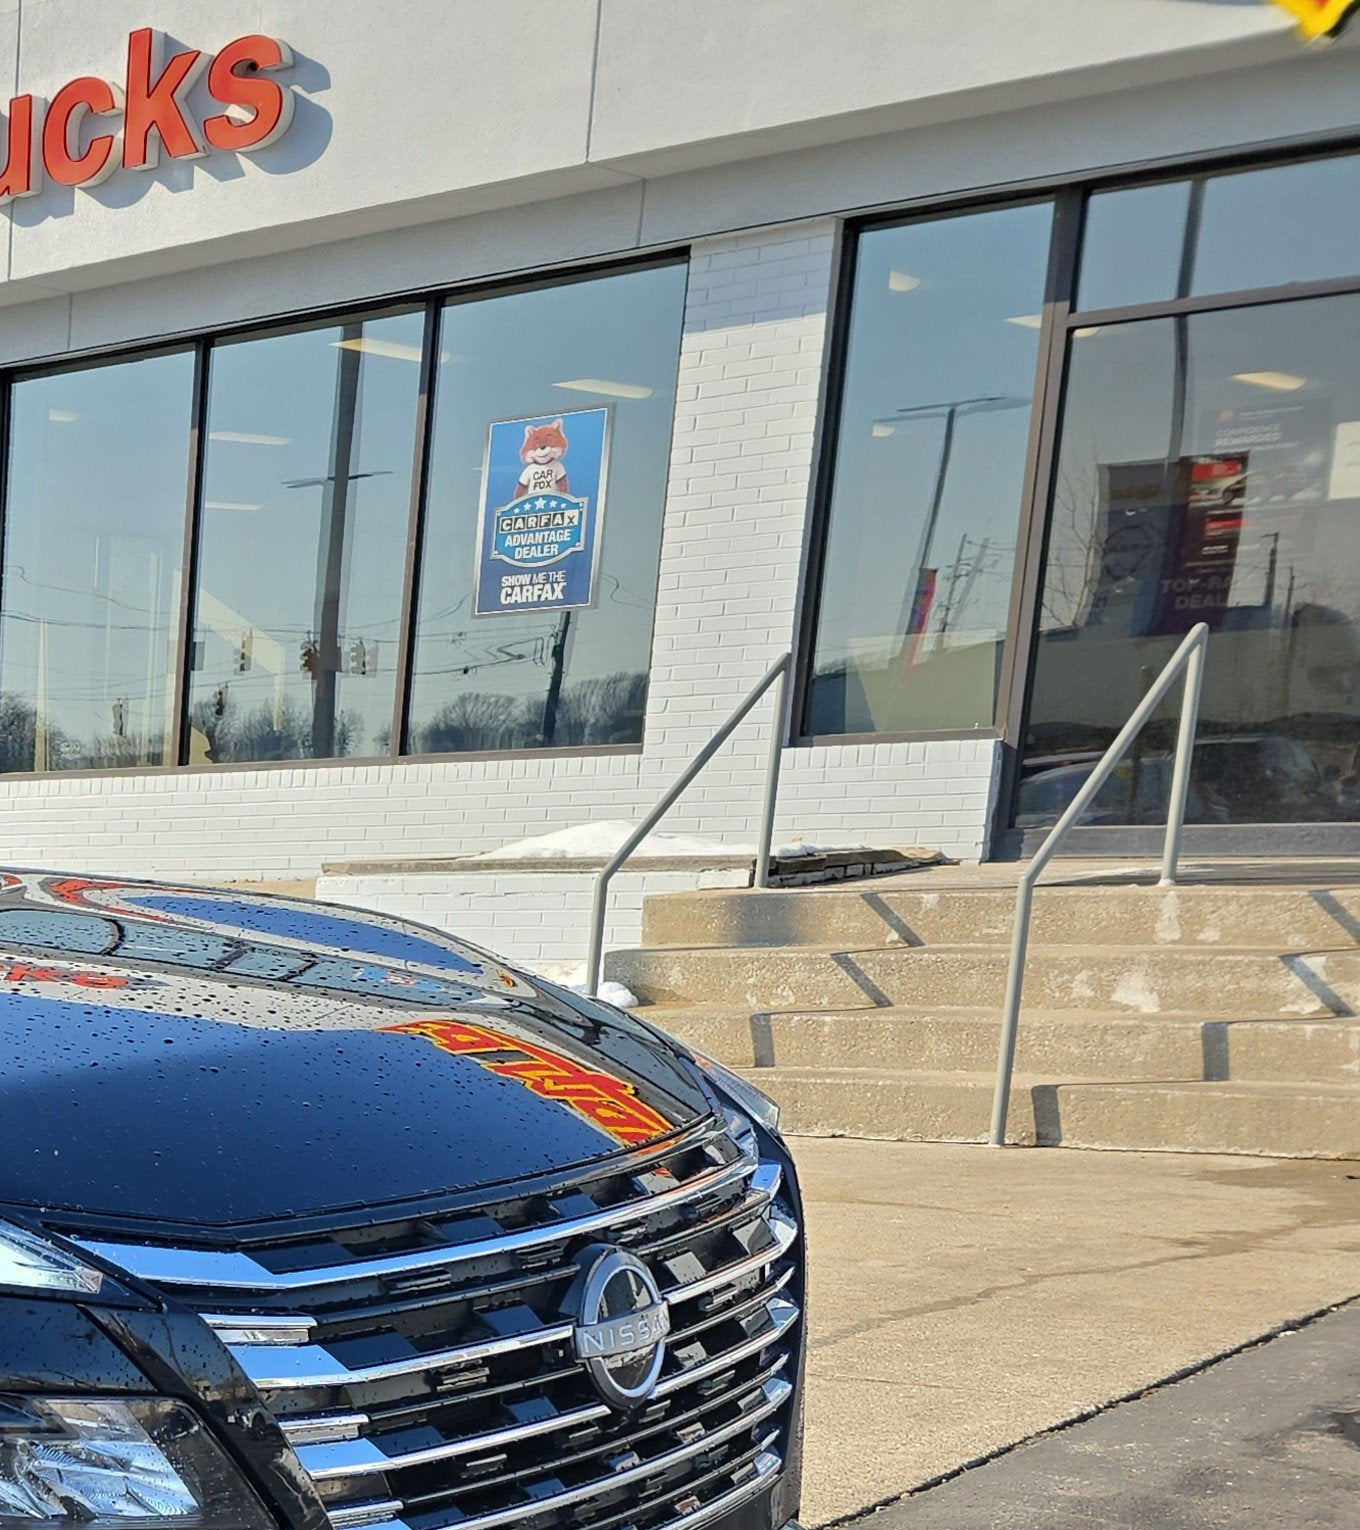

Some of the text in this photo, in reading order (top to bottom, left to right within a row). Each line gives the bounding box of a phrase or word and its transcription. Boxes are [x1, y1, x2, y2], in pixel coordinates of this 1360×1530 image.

[532, 469, 554, 480] CAR
[533, 480, 552, 491] FOX
[500, 510, 578, 533] CARFAX
[504, 528, 572, 547] ADVANTAGE
[514, 543, 559, 560] DEALER
[501, 570, 566, 587] SHOW ME THE
[500, 582, 567, 605] CARFAX
[581, 1307, 670, 1355] NISSAN
